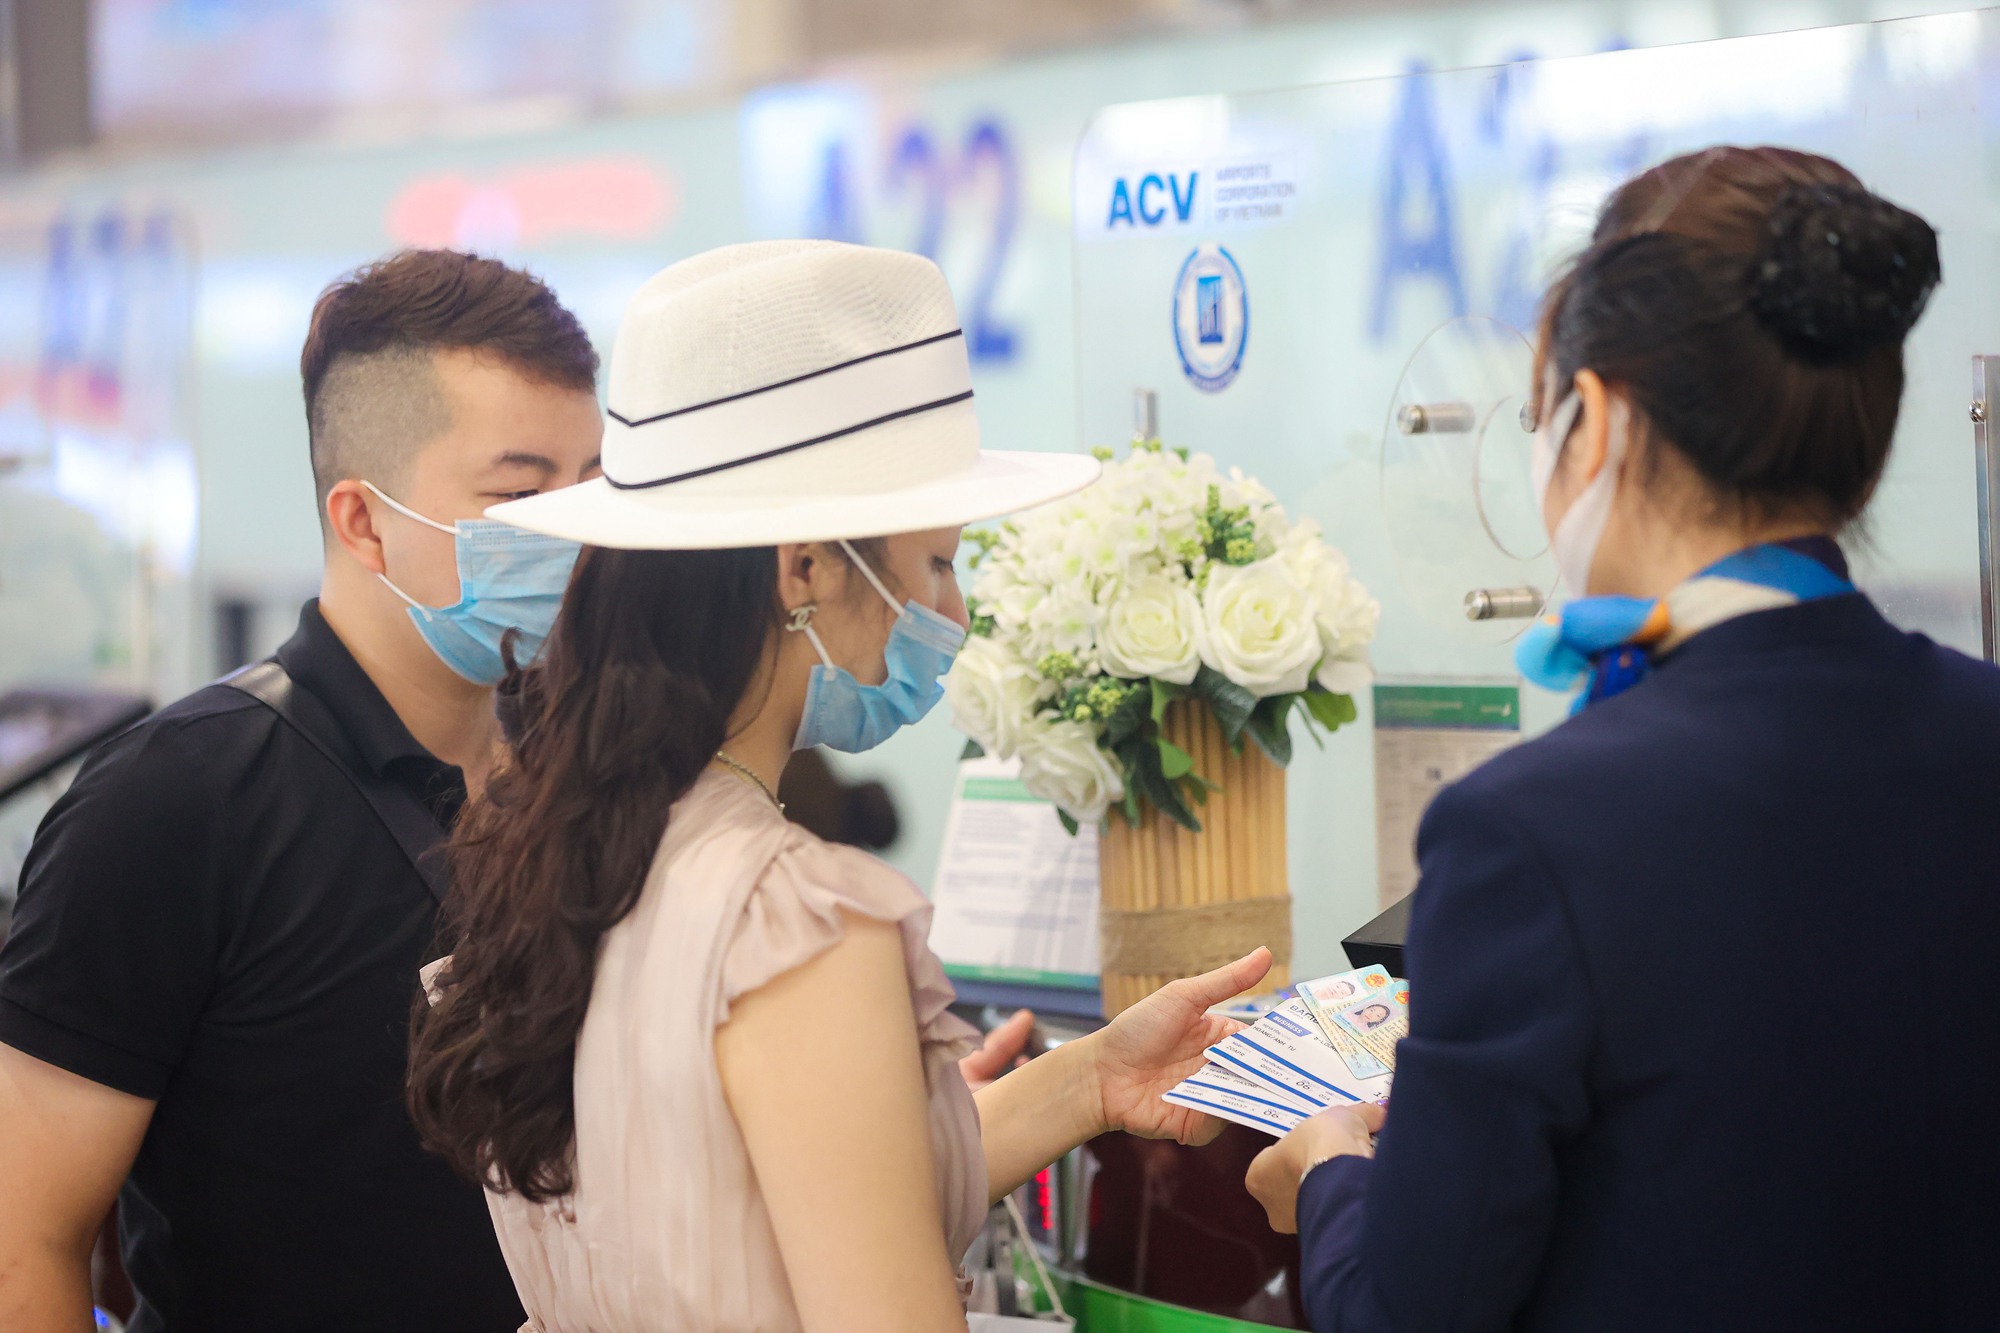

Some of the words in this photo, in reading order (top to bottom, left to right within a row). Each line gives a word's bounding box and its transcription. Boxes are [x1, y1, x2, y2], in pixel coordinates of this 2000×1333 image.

[1107, 171, 1198, 228] ACV
[1216, 182, 1296, 202] CORPORATION
[1273, 1016, 1302, 1034] BUSINESS
[1296, 1081, 1310, 1090] 06
[1263, 1110, 1279, 1119] 06
